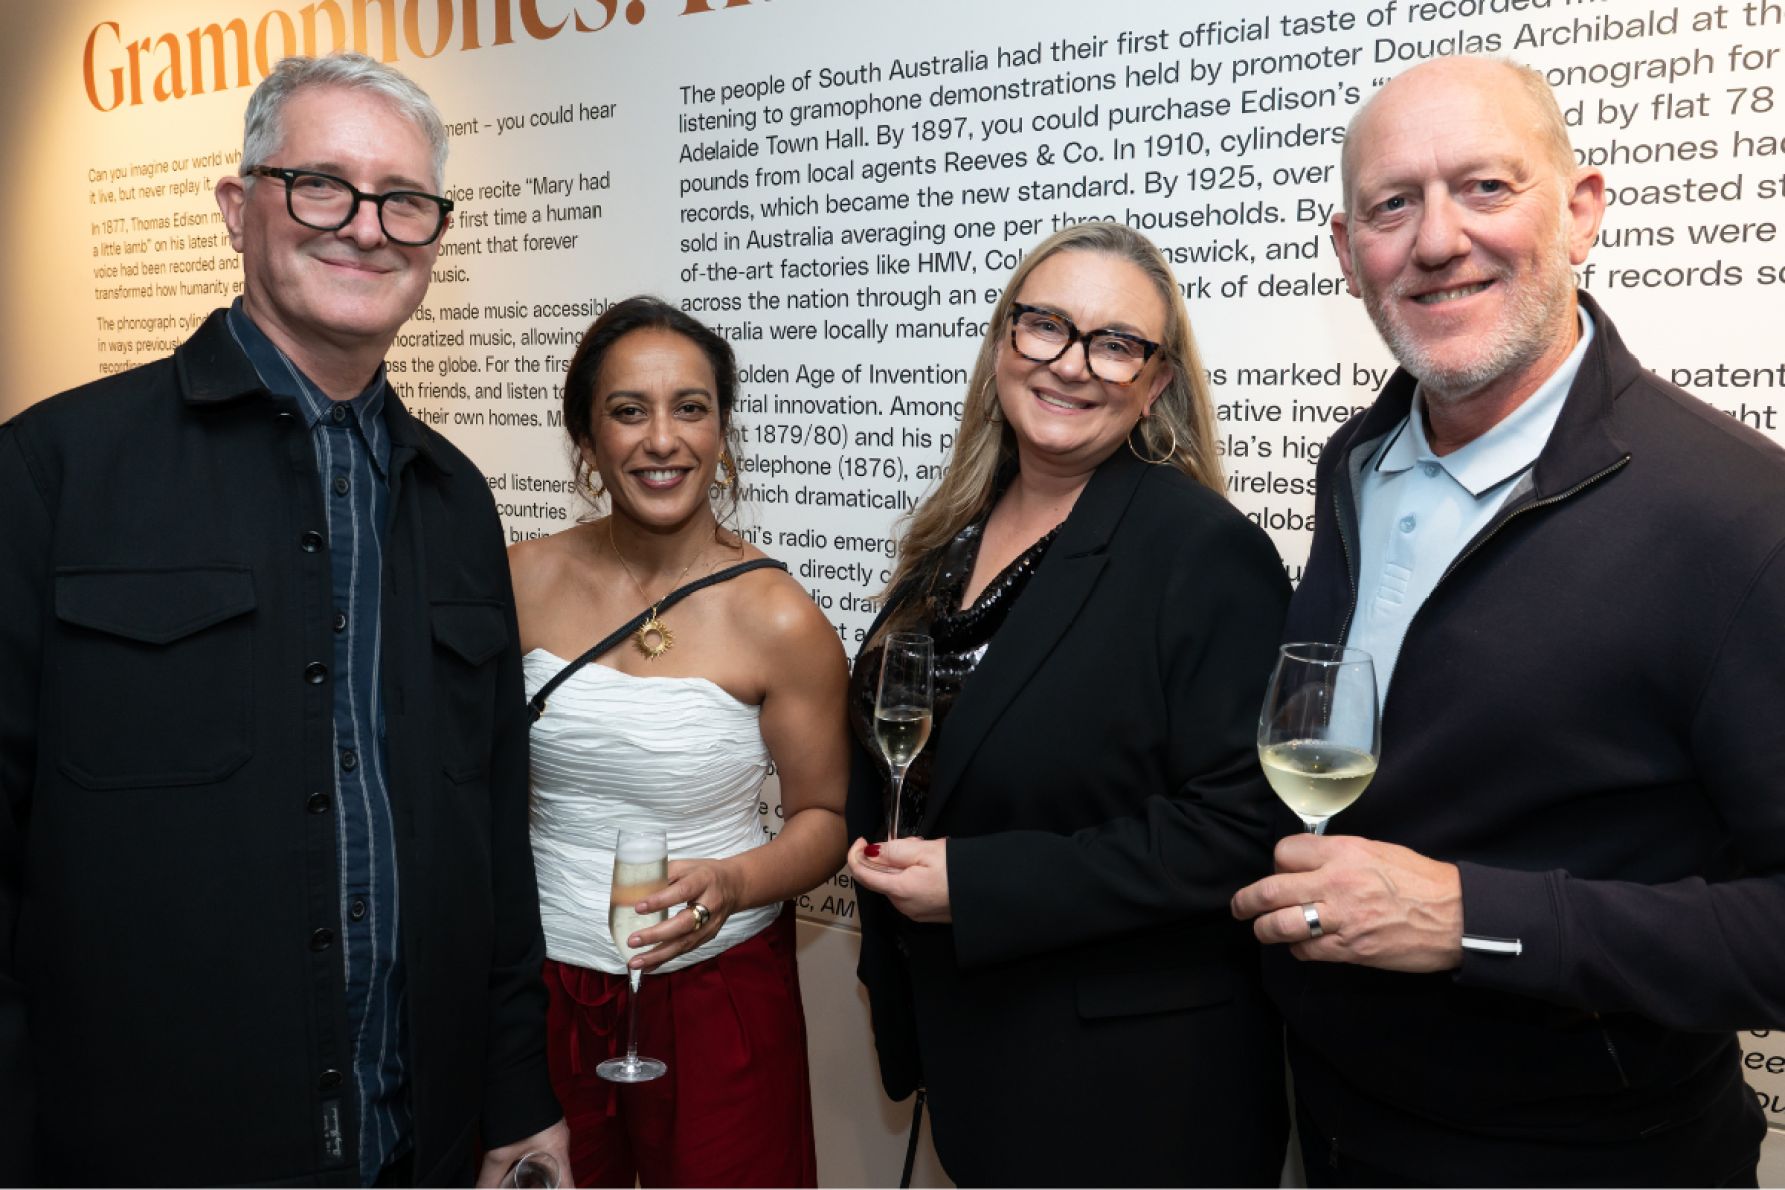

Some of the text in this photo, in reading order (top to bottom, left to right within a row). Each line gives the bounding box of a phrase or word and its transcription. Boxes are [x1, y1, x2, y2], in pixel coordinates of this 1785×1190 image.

[680, 0, 1397, 105] The people of South Australia had their first official taste of
[1728, 44, 1780, 71] for
[680, 108, 756, 133] listening
[763, 106, 783, 124] to
[790, 93, 921, 126] gramophone
[930, 71, 1116, 107] demonstrations
[1126, 61, 1179, 88] held
[1191, 58, 1222, 85] by
[1233, 46, 1363, 83] promoter
[1375, 30, 1501, 63] Douglas
[1513, 7, 1678, 49] Archibald
[1693, 5, 1728, 31] at
[497, 103, 616, 135] you could hear
[1598, 86, 1773, 130] by flat 78
[680, 138, 759, 163] Adelaide
[766, 135, 818, 155] Town
[827, 127, 869, 149] Hall.
[877, 125, 904, 149] By
[912, 117, 973, 141] 1897,
[981, 117, 1022, 141] you
[1032, 104, 1098, 131] could
[1109, 98, 1230, 131] purchase
[88, 152, 222, 183] Can you imagine our world
[680, 169, 748, 198] pounds
[755, 168, 800, 187] from
[808, 160, 854, 183] local
[862, 156, 936, 183] agents
[945, 152, 1027, 173] Reeves
[1037, 144, 1055, 165] &
[1063, 142, 1104, 164] Co.
[1114, 138, 1135, 160] In
[1145, 132, 1209, 158] 1910,
[89, 191, 96, 204] it
[119, 187, 136, 201] but
[138, 185, 166, 198] never
[169, 178, 200, 197] replay
[479, 180, 521, 199] recite
[580, 171, 610, 191] had
[681, 165, 1334, 223] records, which became the new standard. By 1925, over
[92, 212, 208, 235] In 1877, Thomas Edison
[459, 204, 601, 228] first time a human
[681, 199, 1334, 253] sold in Australia averaging one per households. By
[93, 247, 98, 257] a
[101, 242, 121, 256] little
[154, 241, 167, 252] on
[170, 237, 185, 250] his
[188, 234, 217, 249] latest
[487, 233, 578, 253] that forever
[1688, 223, 1776, 244] were
[1266, 235, 1318, 260] and
[94, 254, 240, 279] voice had been recorded and
[681, 251, 976, 282] of-the-art factories like HMV,
[1609, 260, 1742, 288] records
[95, 280, 228, 299] transformed how humanity
[681, 285, 976, 311] across the nation through an
[1221, 275, 1248, 298] of
[97, 314, 176, 332] The phonograph
[440, 301, 528, 320] made music
[470, 327, 583, 348] music, allowing
[770, 318, 888, 344] were locally
[98, 338, 133, 354] in ways
[411, 355, 540, 377] the globe. For the
[796, 364, 862, 388] Age of
[1238, 363, 1388, 391] marked by
[418, 382, 548, 400] friends, and listen
[418, 407, 542, 427] their own homes.
[775, 394, 882, 415] innovation.
[755, 424, 931, 449] 1879/80) and his
[736, 454, 908, 482] telephone (1876),
[512, 474, 576, 494] listeners
[736, 483, 919, 515] which dramatically
[779, 529, 827, 549] radio
[800, 559, 873, 586] directly
